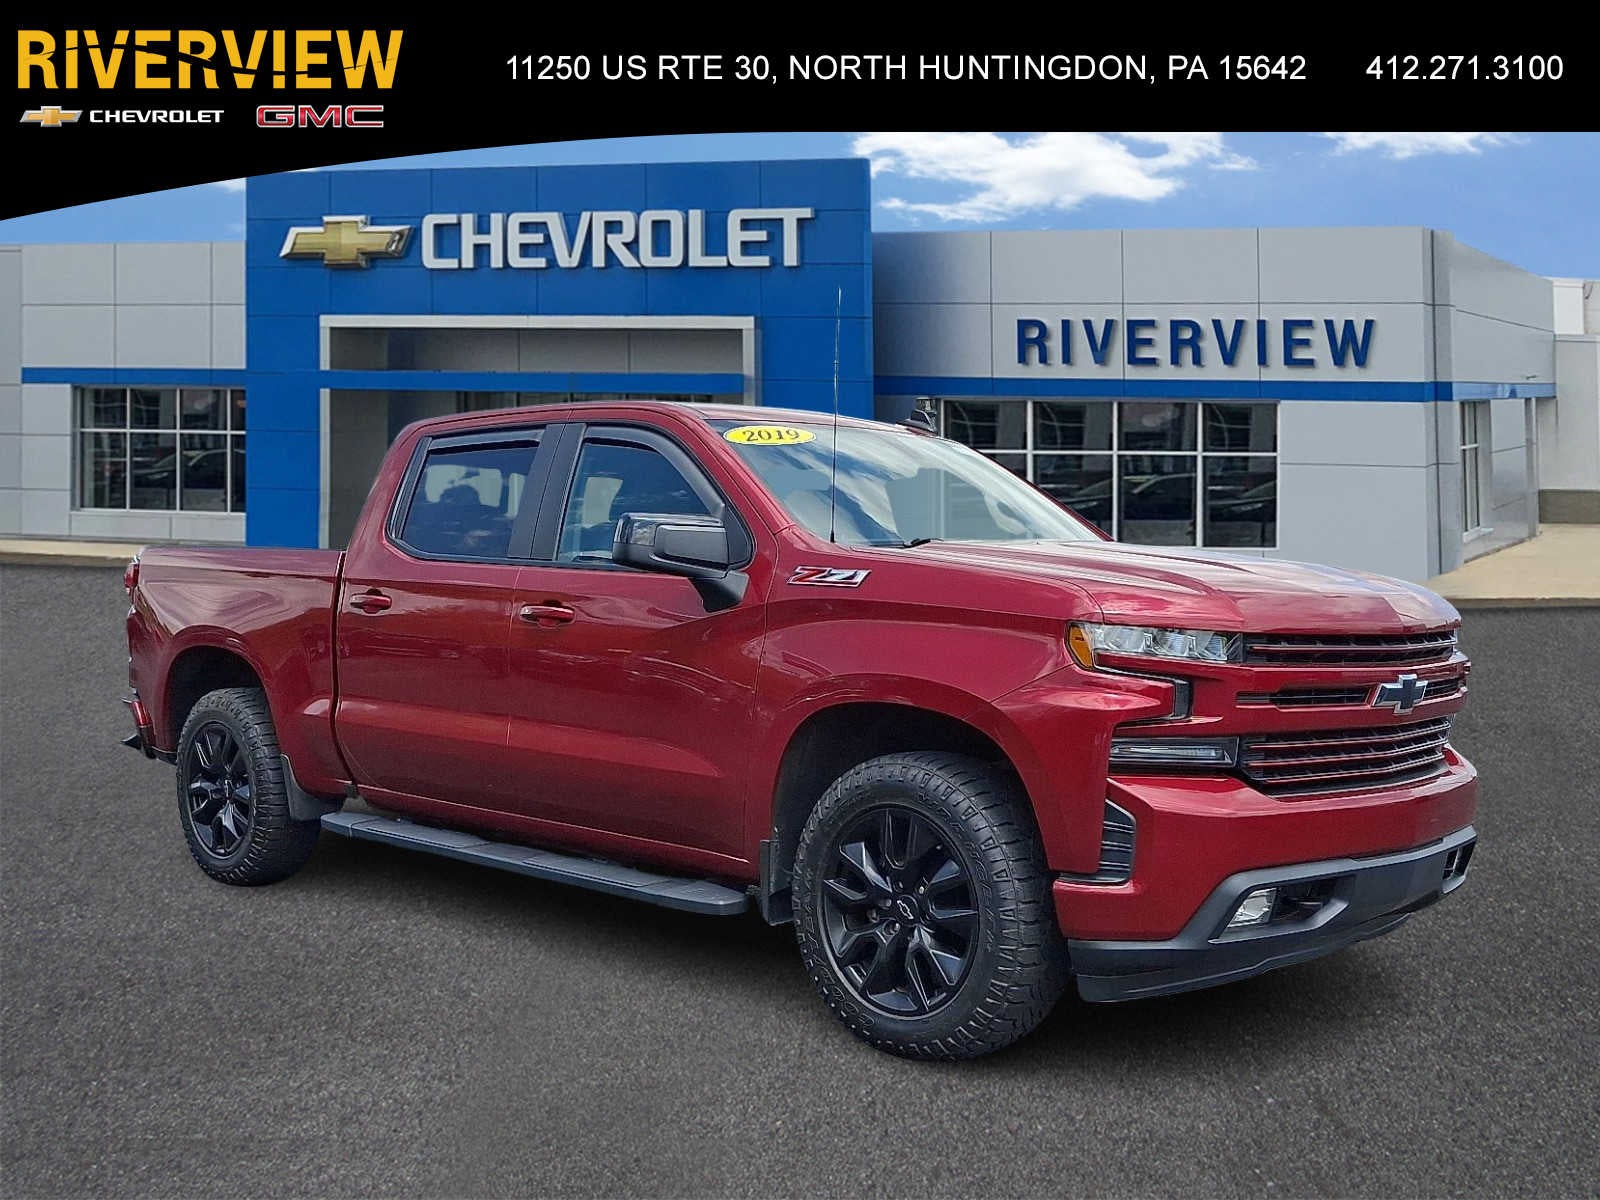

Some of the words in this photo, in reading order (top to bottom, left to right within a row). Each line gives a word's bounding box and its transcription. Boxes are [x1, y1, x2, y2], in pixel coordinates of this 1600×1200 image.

[421, 207, 815, 270] CHEVROLET
[1016, 318, 1376, 368] RIVERVIEW
[742, 428, 801, 442] 2019
